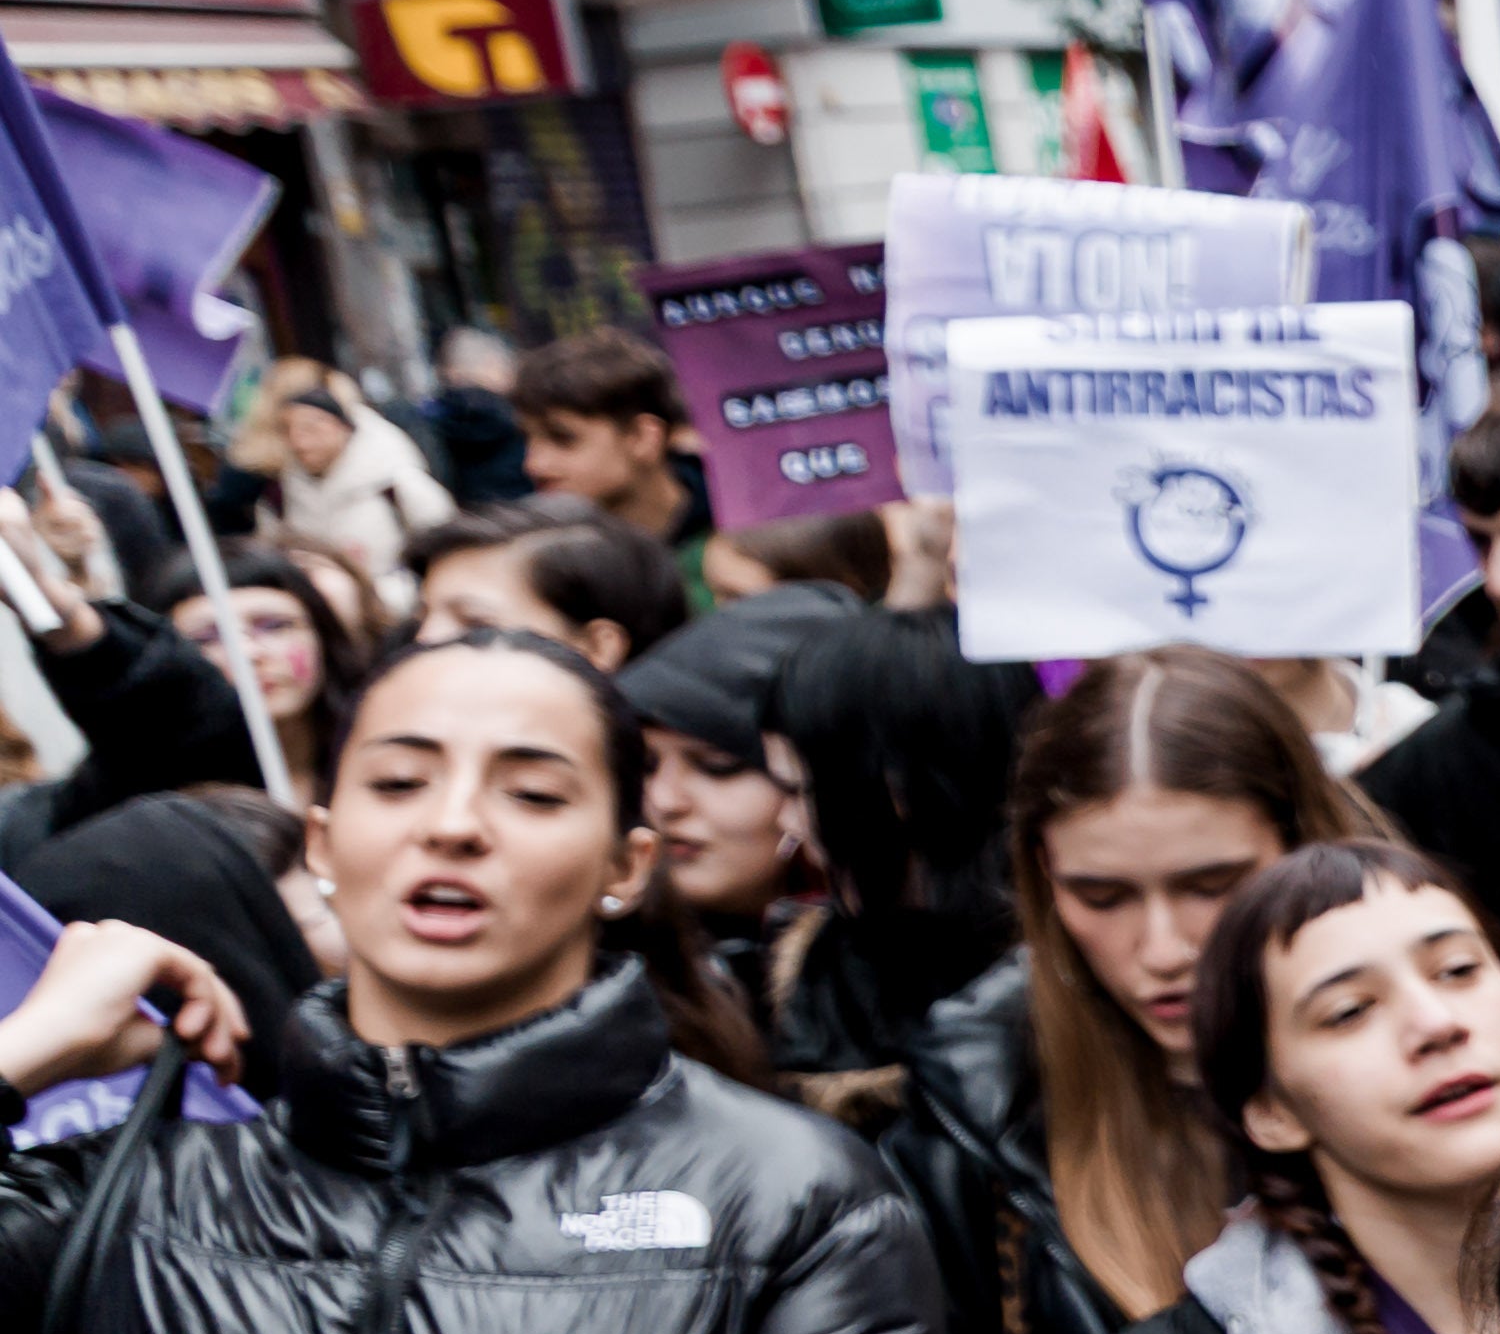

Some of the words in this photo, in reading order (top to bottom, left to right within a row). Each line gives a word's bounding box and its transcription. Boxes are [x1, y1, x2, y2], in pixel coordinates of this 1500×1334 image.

[661, 277, 824, 328] AUNQUE
[983, 368, 1377, 418] ANTIRRACISTAS
[780, 443, 869, 485] QUE
[601, 1191, 657, 1213] THE
